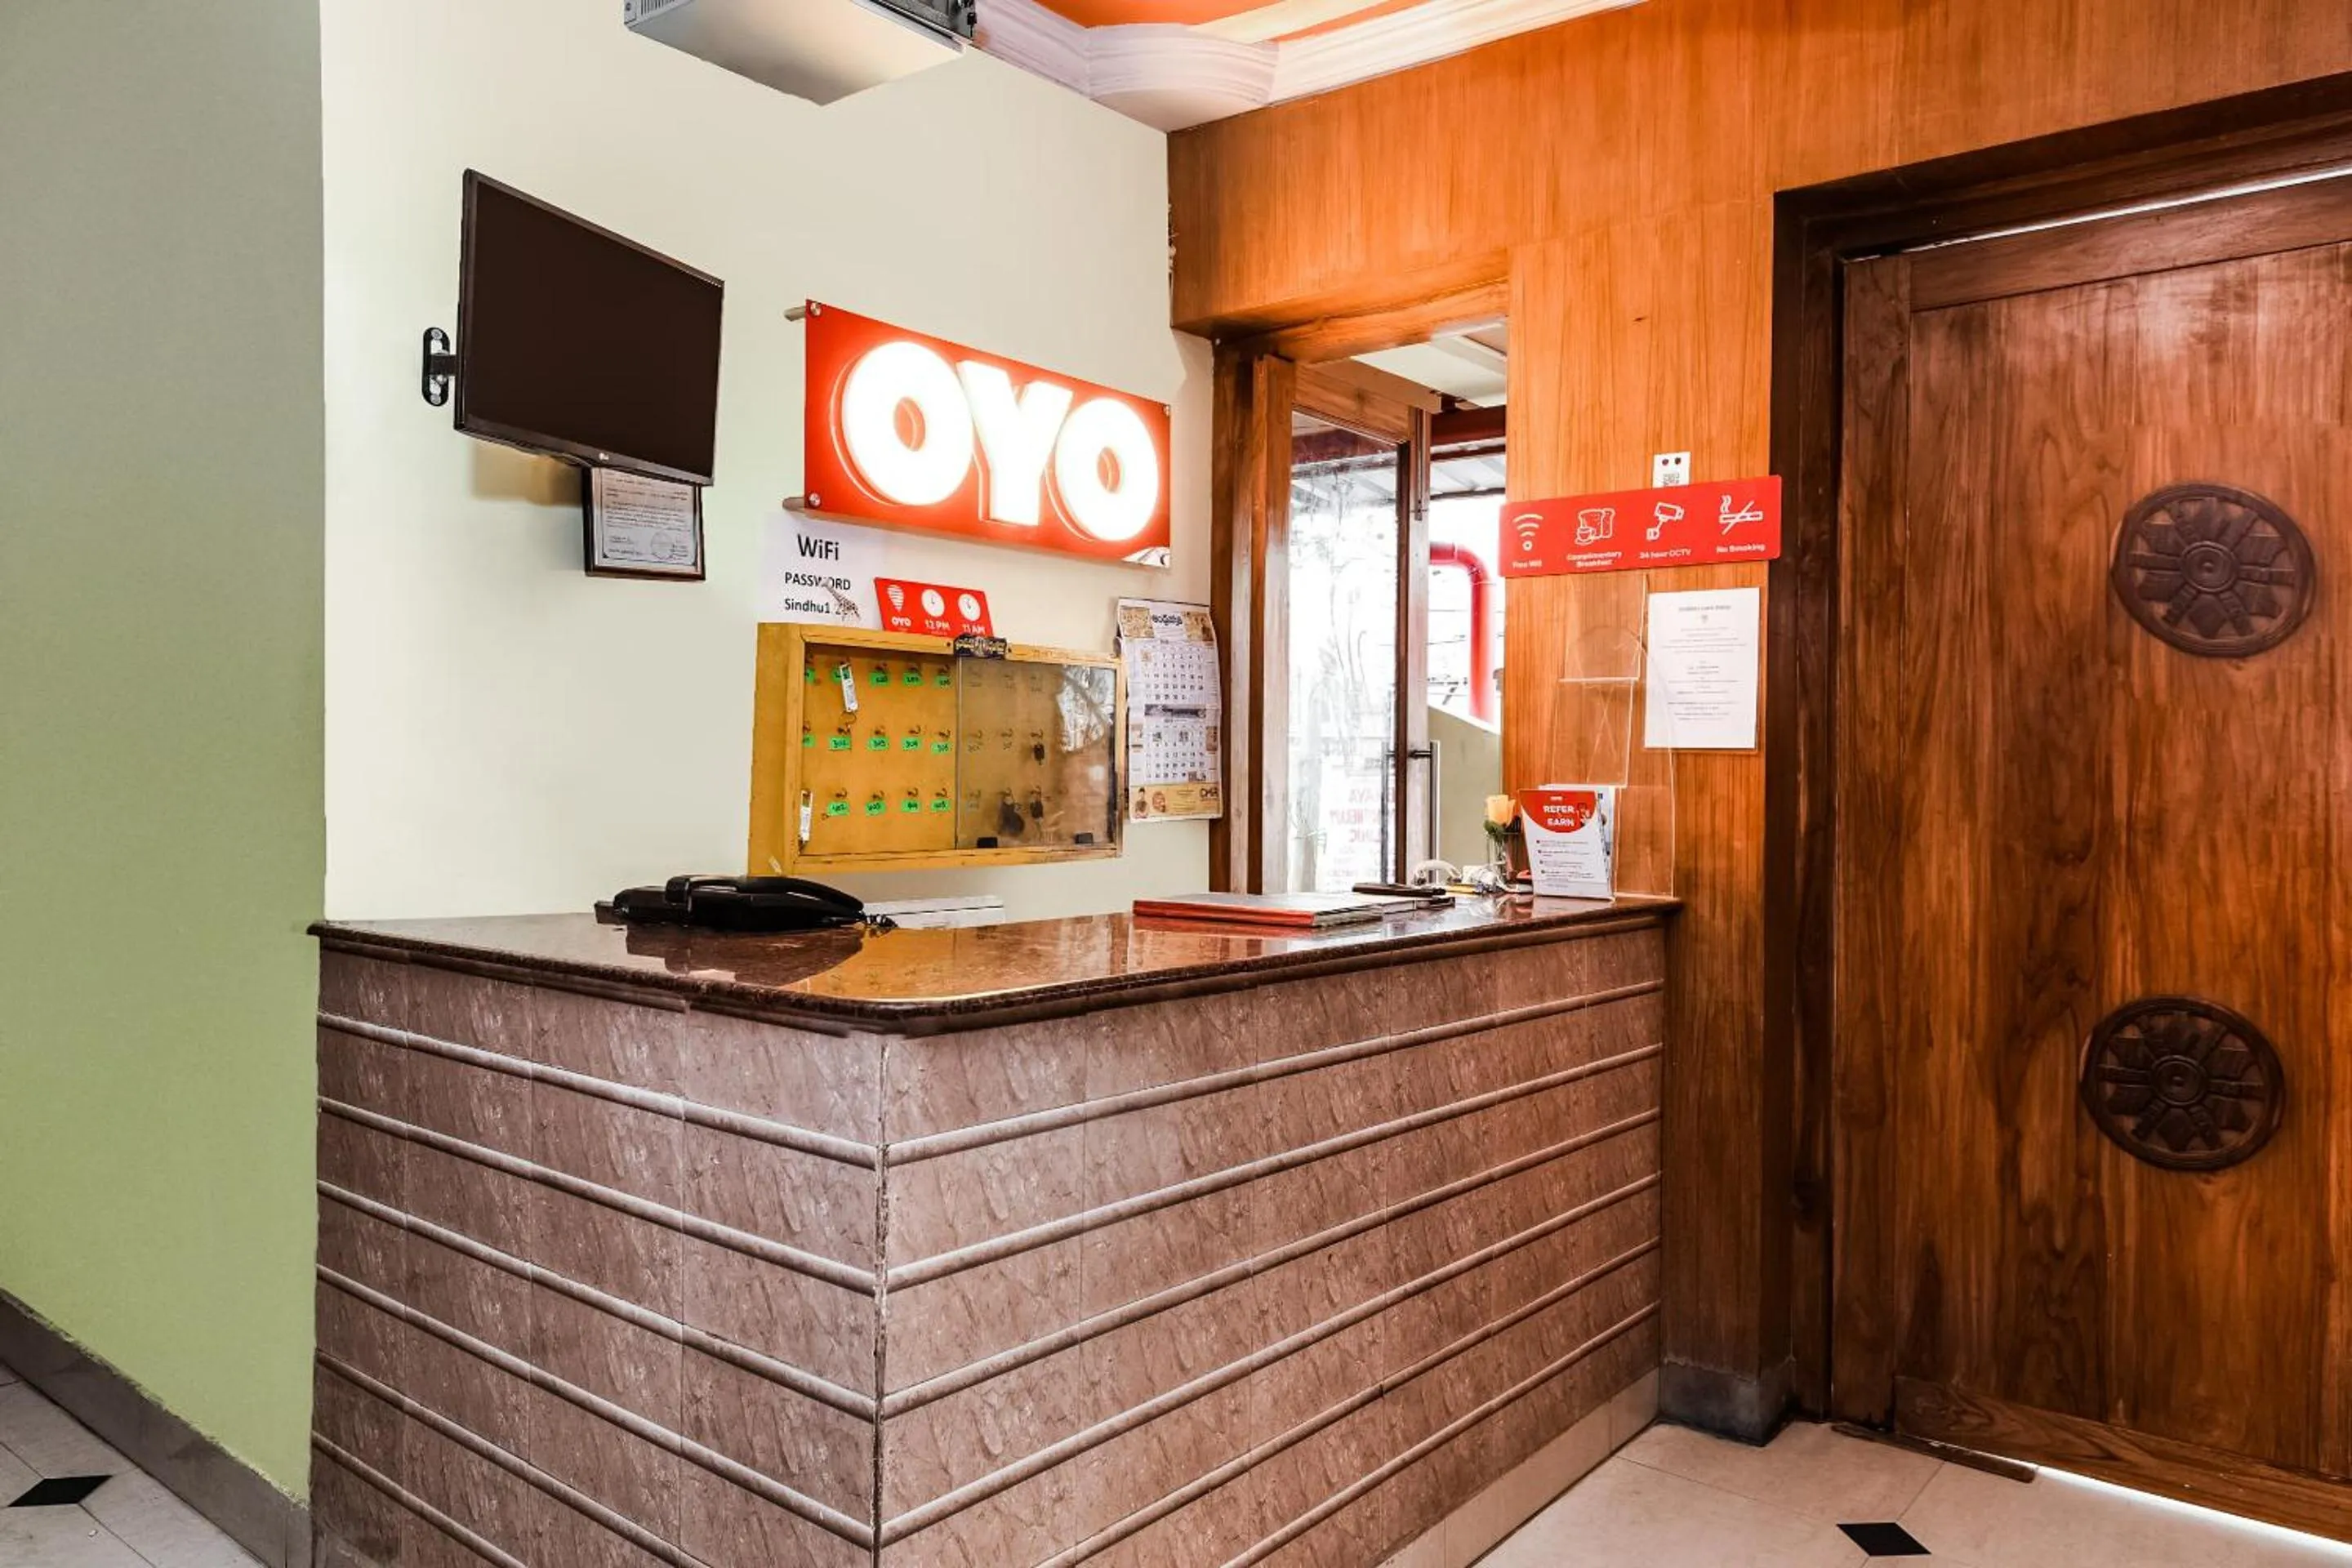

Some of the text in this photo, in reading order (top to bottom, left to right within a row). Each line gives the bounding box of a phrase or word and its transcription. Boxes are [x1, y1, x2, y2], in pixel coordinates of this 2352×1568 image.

[833, 340, 1160, 542] OYO
[797, 533, 840, 561] WiFi
[891, 616, 911, 627] OYO
[1542, 804, 1575, 814] REFER
[1546, 817, 1575, 827] EARN
